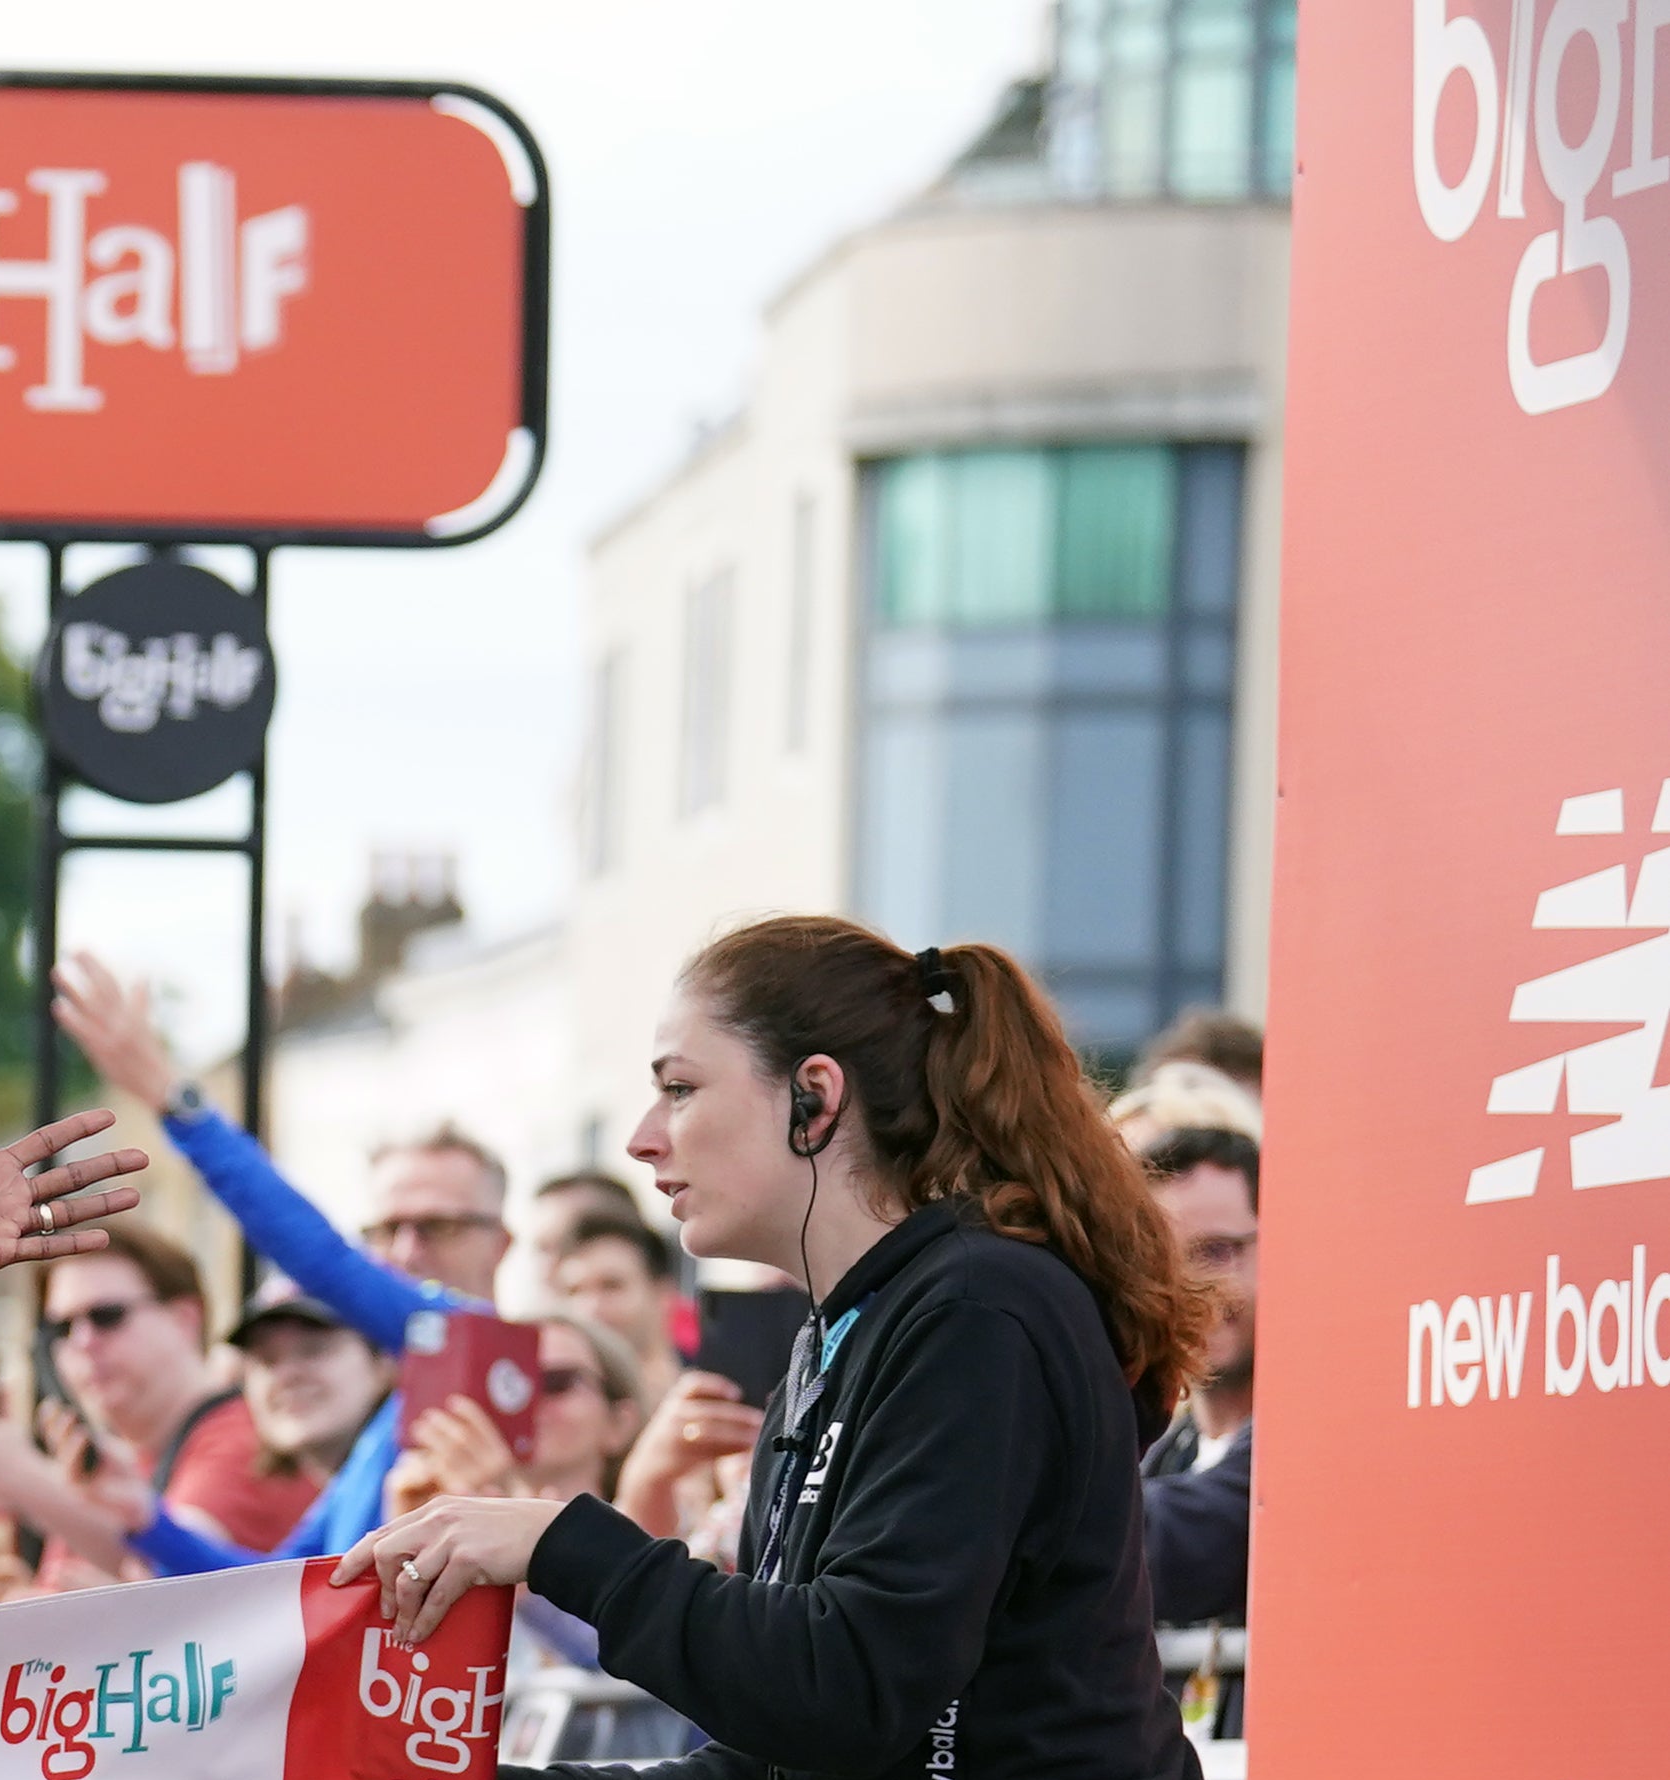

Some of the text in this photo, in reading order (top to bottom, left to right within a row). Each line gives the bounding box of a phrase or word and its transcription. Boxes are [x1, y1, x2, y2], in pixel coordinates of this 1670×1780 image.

[1413, 0, 1670, 416] big
[1407, 1290, 1533, 1409] new
[25, 1657, 55, 1677] The
